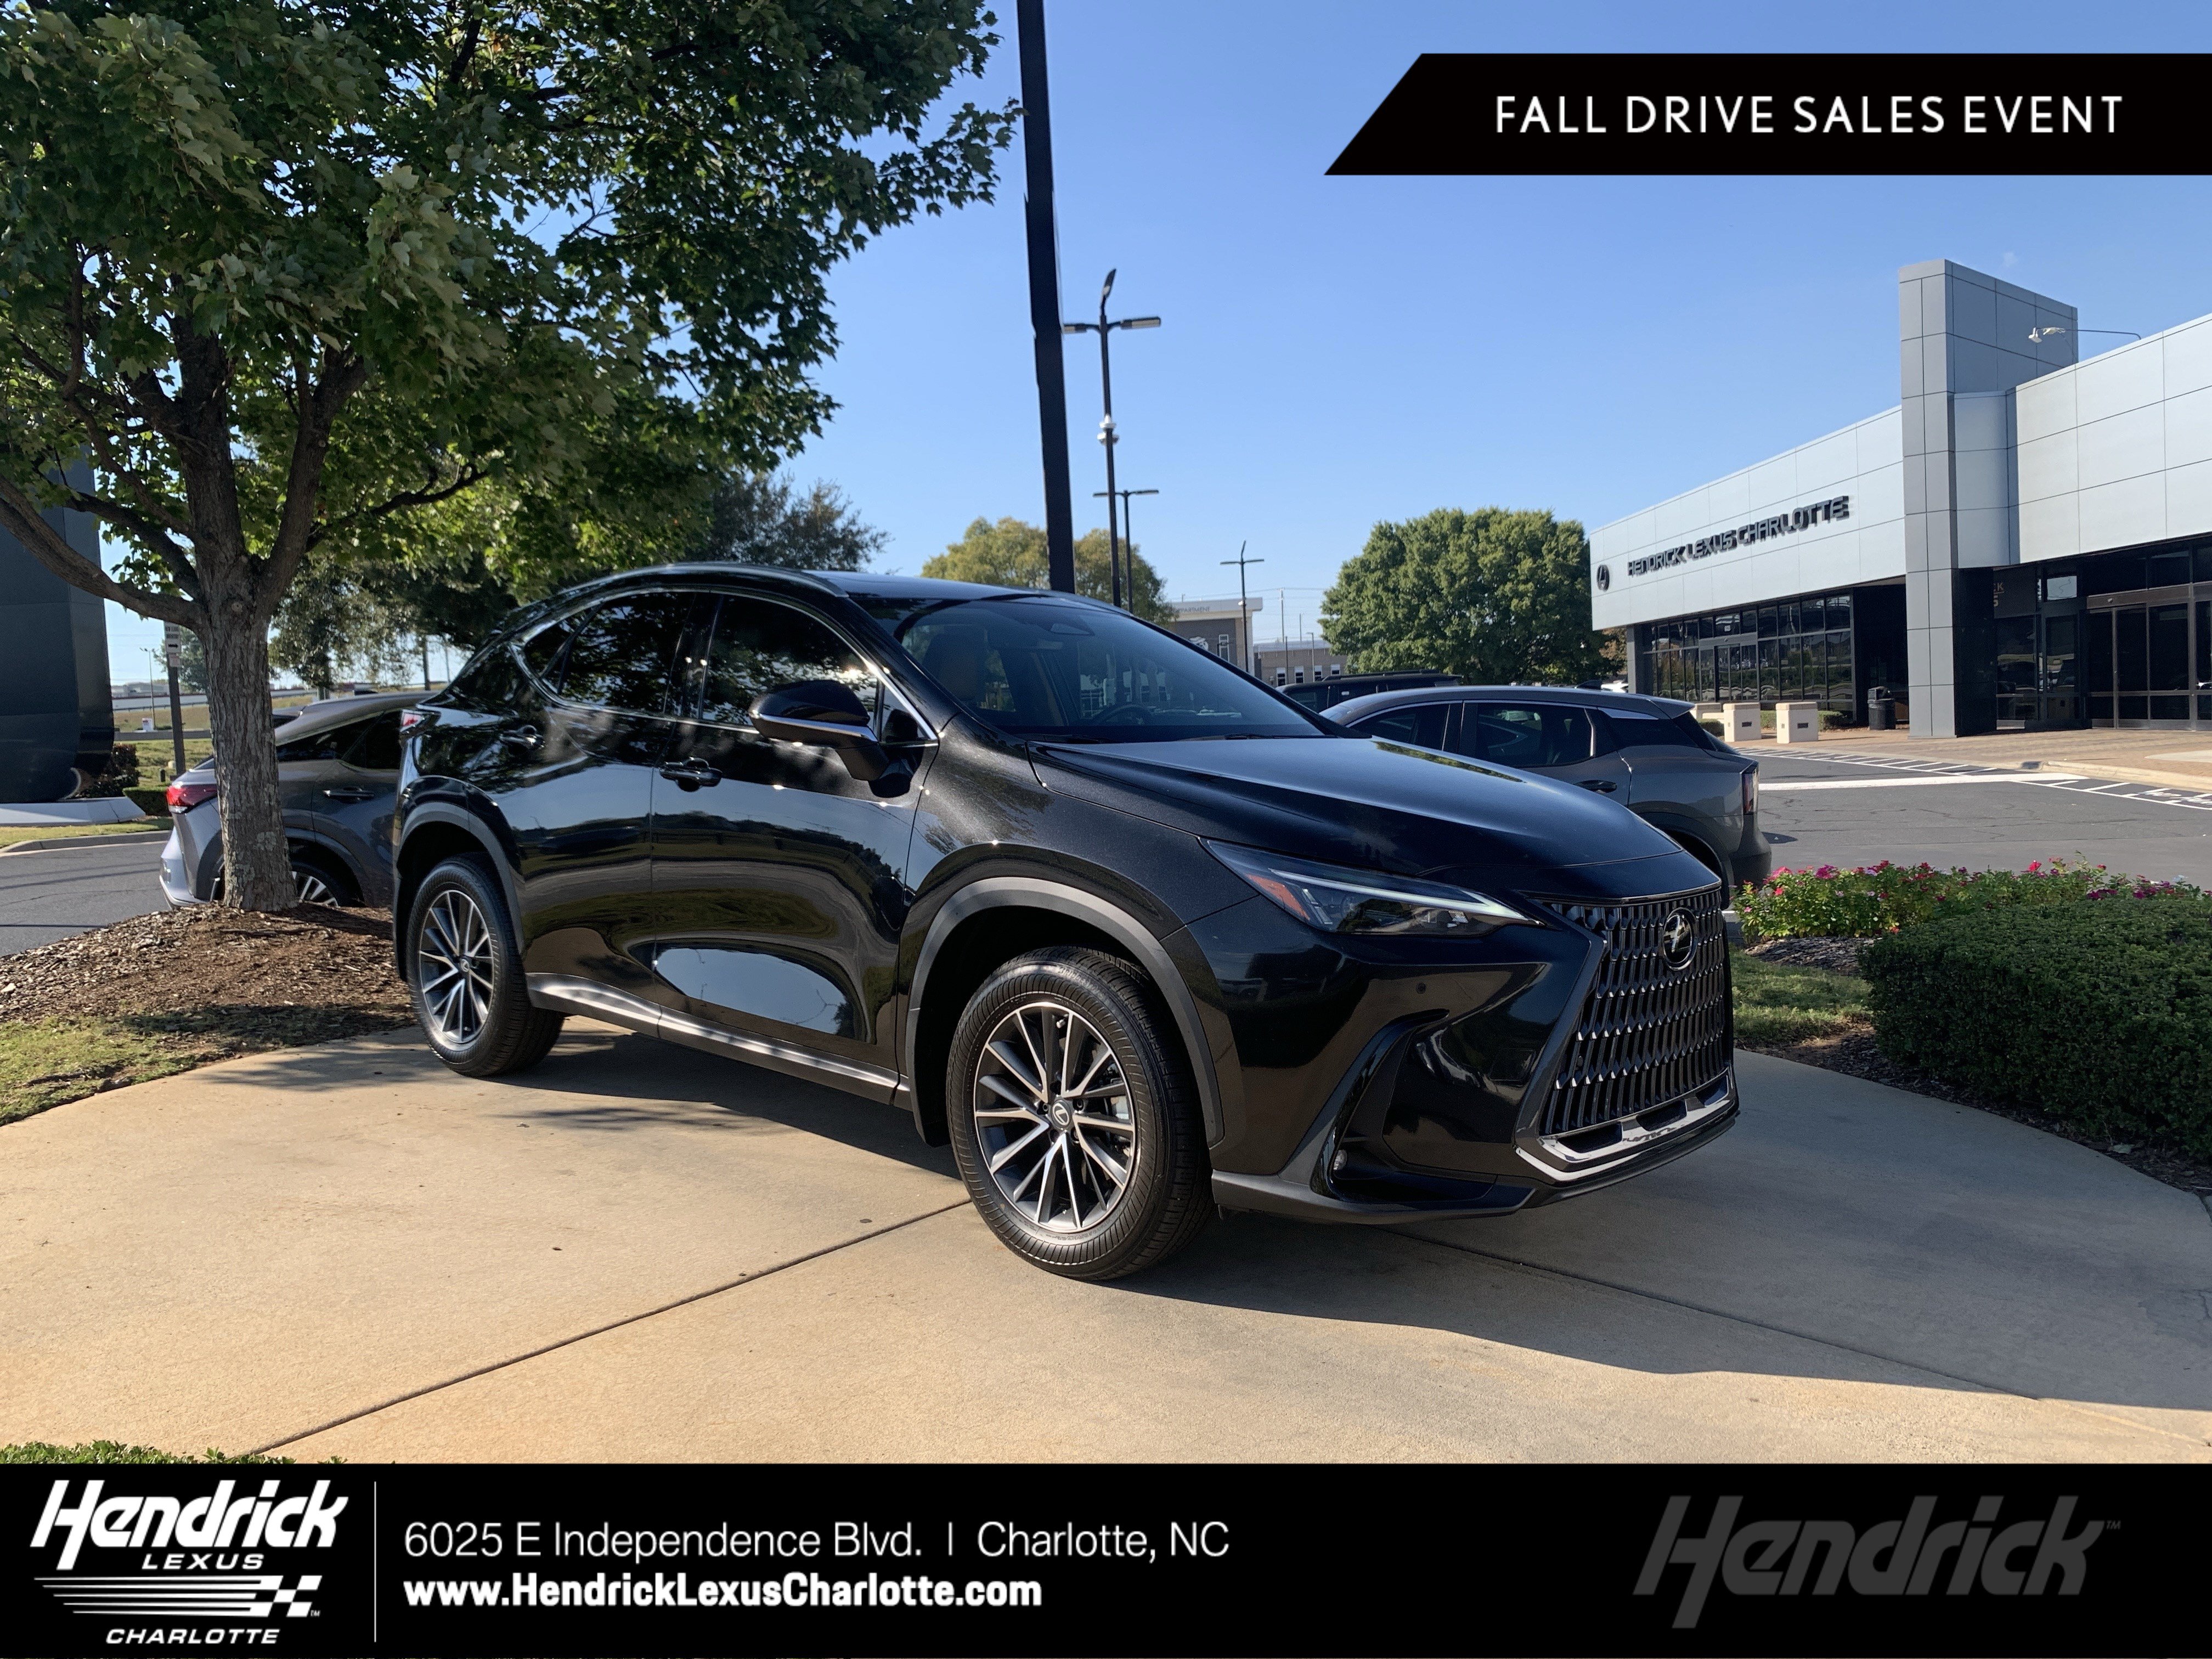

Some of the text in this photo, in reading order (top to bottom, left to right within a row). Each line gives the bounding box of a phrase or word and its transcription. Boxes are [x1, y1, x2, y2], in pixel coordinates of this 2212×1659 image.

[1628, 495, 1849, 577] HENDRICK LEXUS CHARLOTTE
